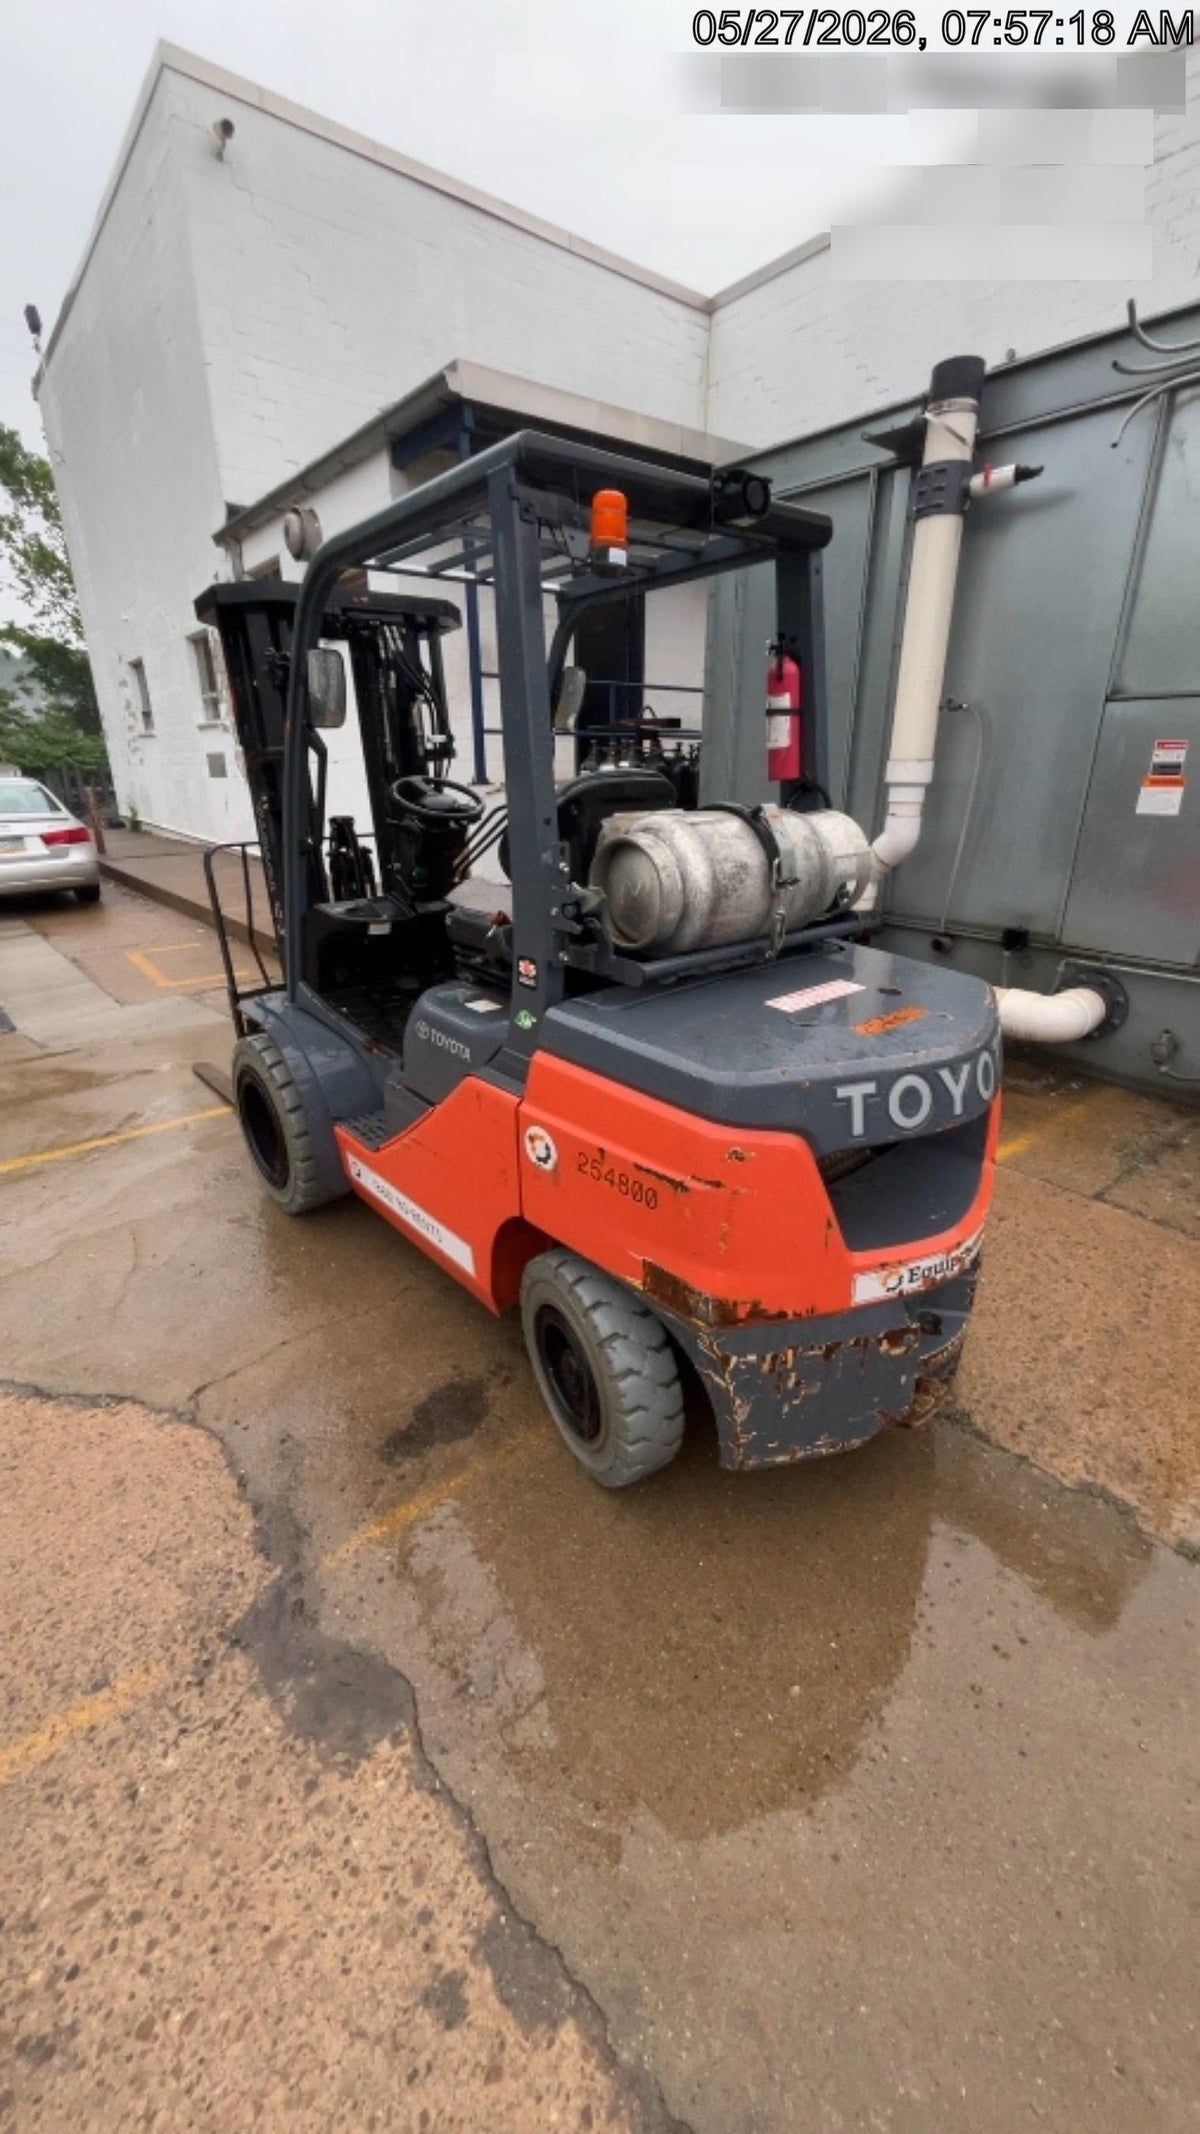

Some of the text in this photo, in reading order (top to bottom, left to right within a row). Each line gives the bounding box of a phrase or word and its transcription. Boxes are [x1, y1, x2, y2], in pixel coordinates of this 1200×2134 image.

[430, 1027, 472, 1062] TOYOTA
[835, 1032, 1001, 1137] TOYO
[577, 1151, 658, 1210] 254800
